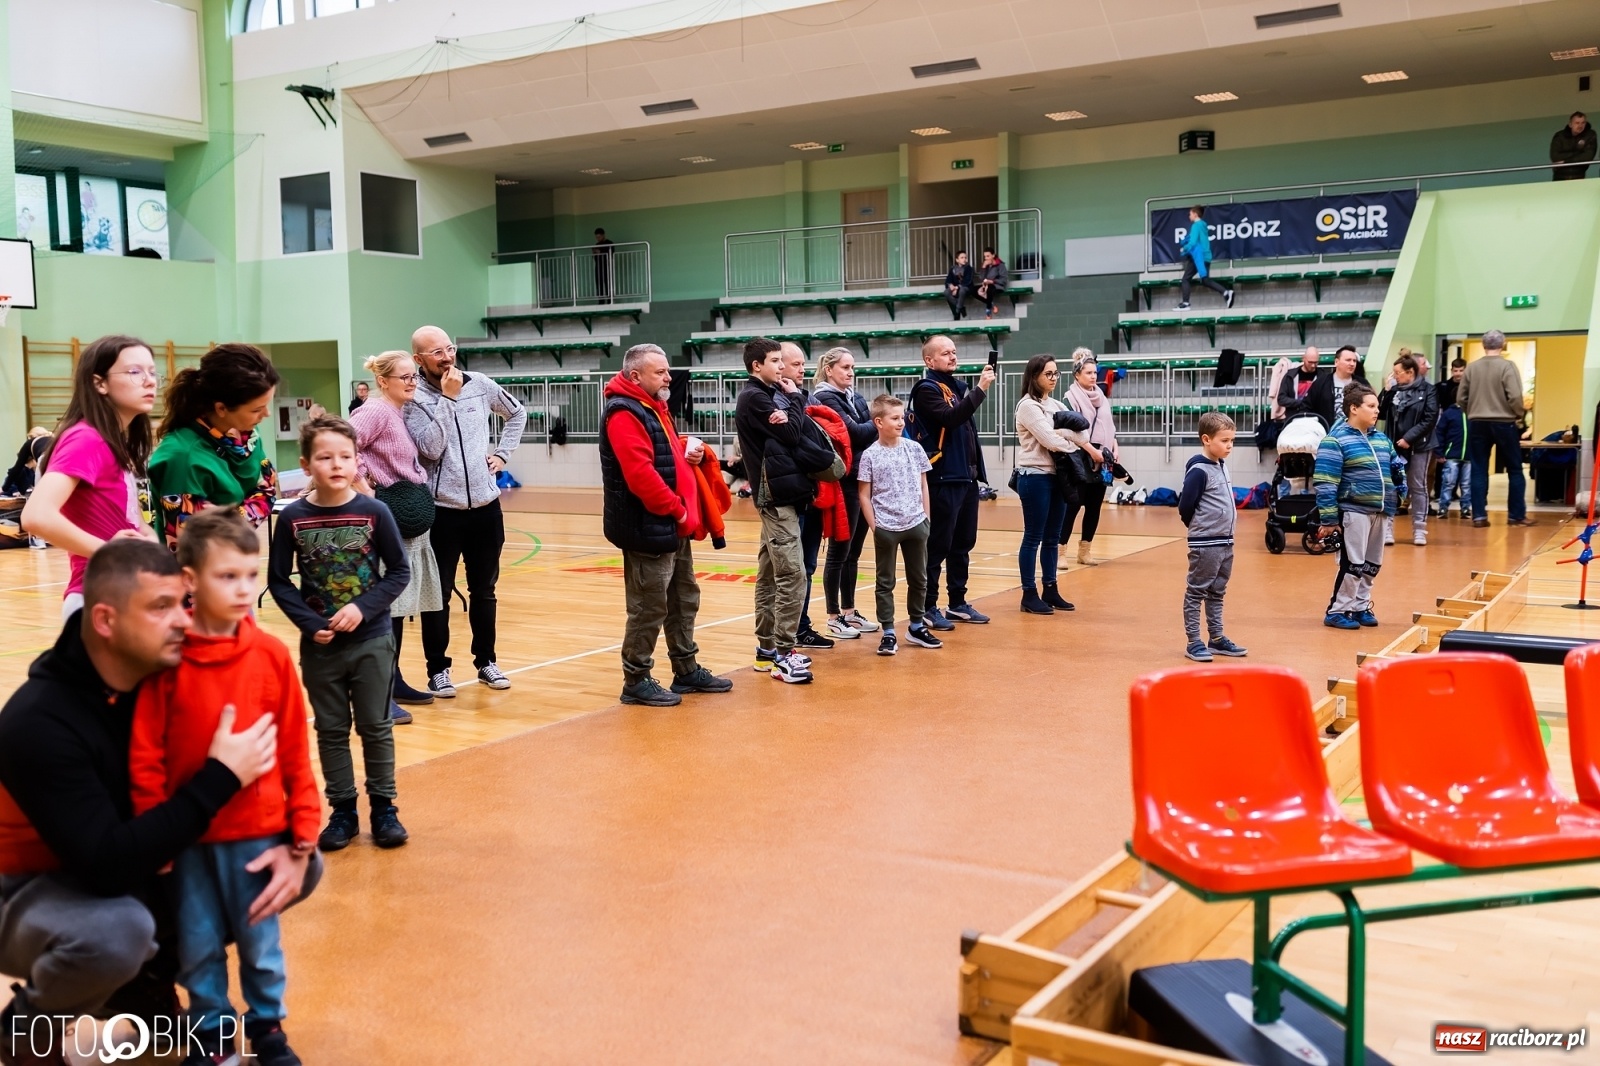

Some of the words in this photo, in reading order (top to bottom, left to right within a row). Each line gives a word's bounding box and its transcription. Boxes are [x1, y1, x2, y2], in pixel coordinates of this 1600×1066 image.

[1197, 137, 1209, 148] E
[1315, 204, 1389, 233] OSiR
[1174, 217, 1281, 244] RCIBÓRZ
[1343, 229, 1388, 240] RACIBÓRZ
